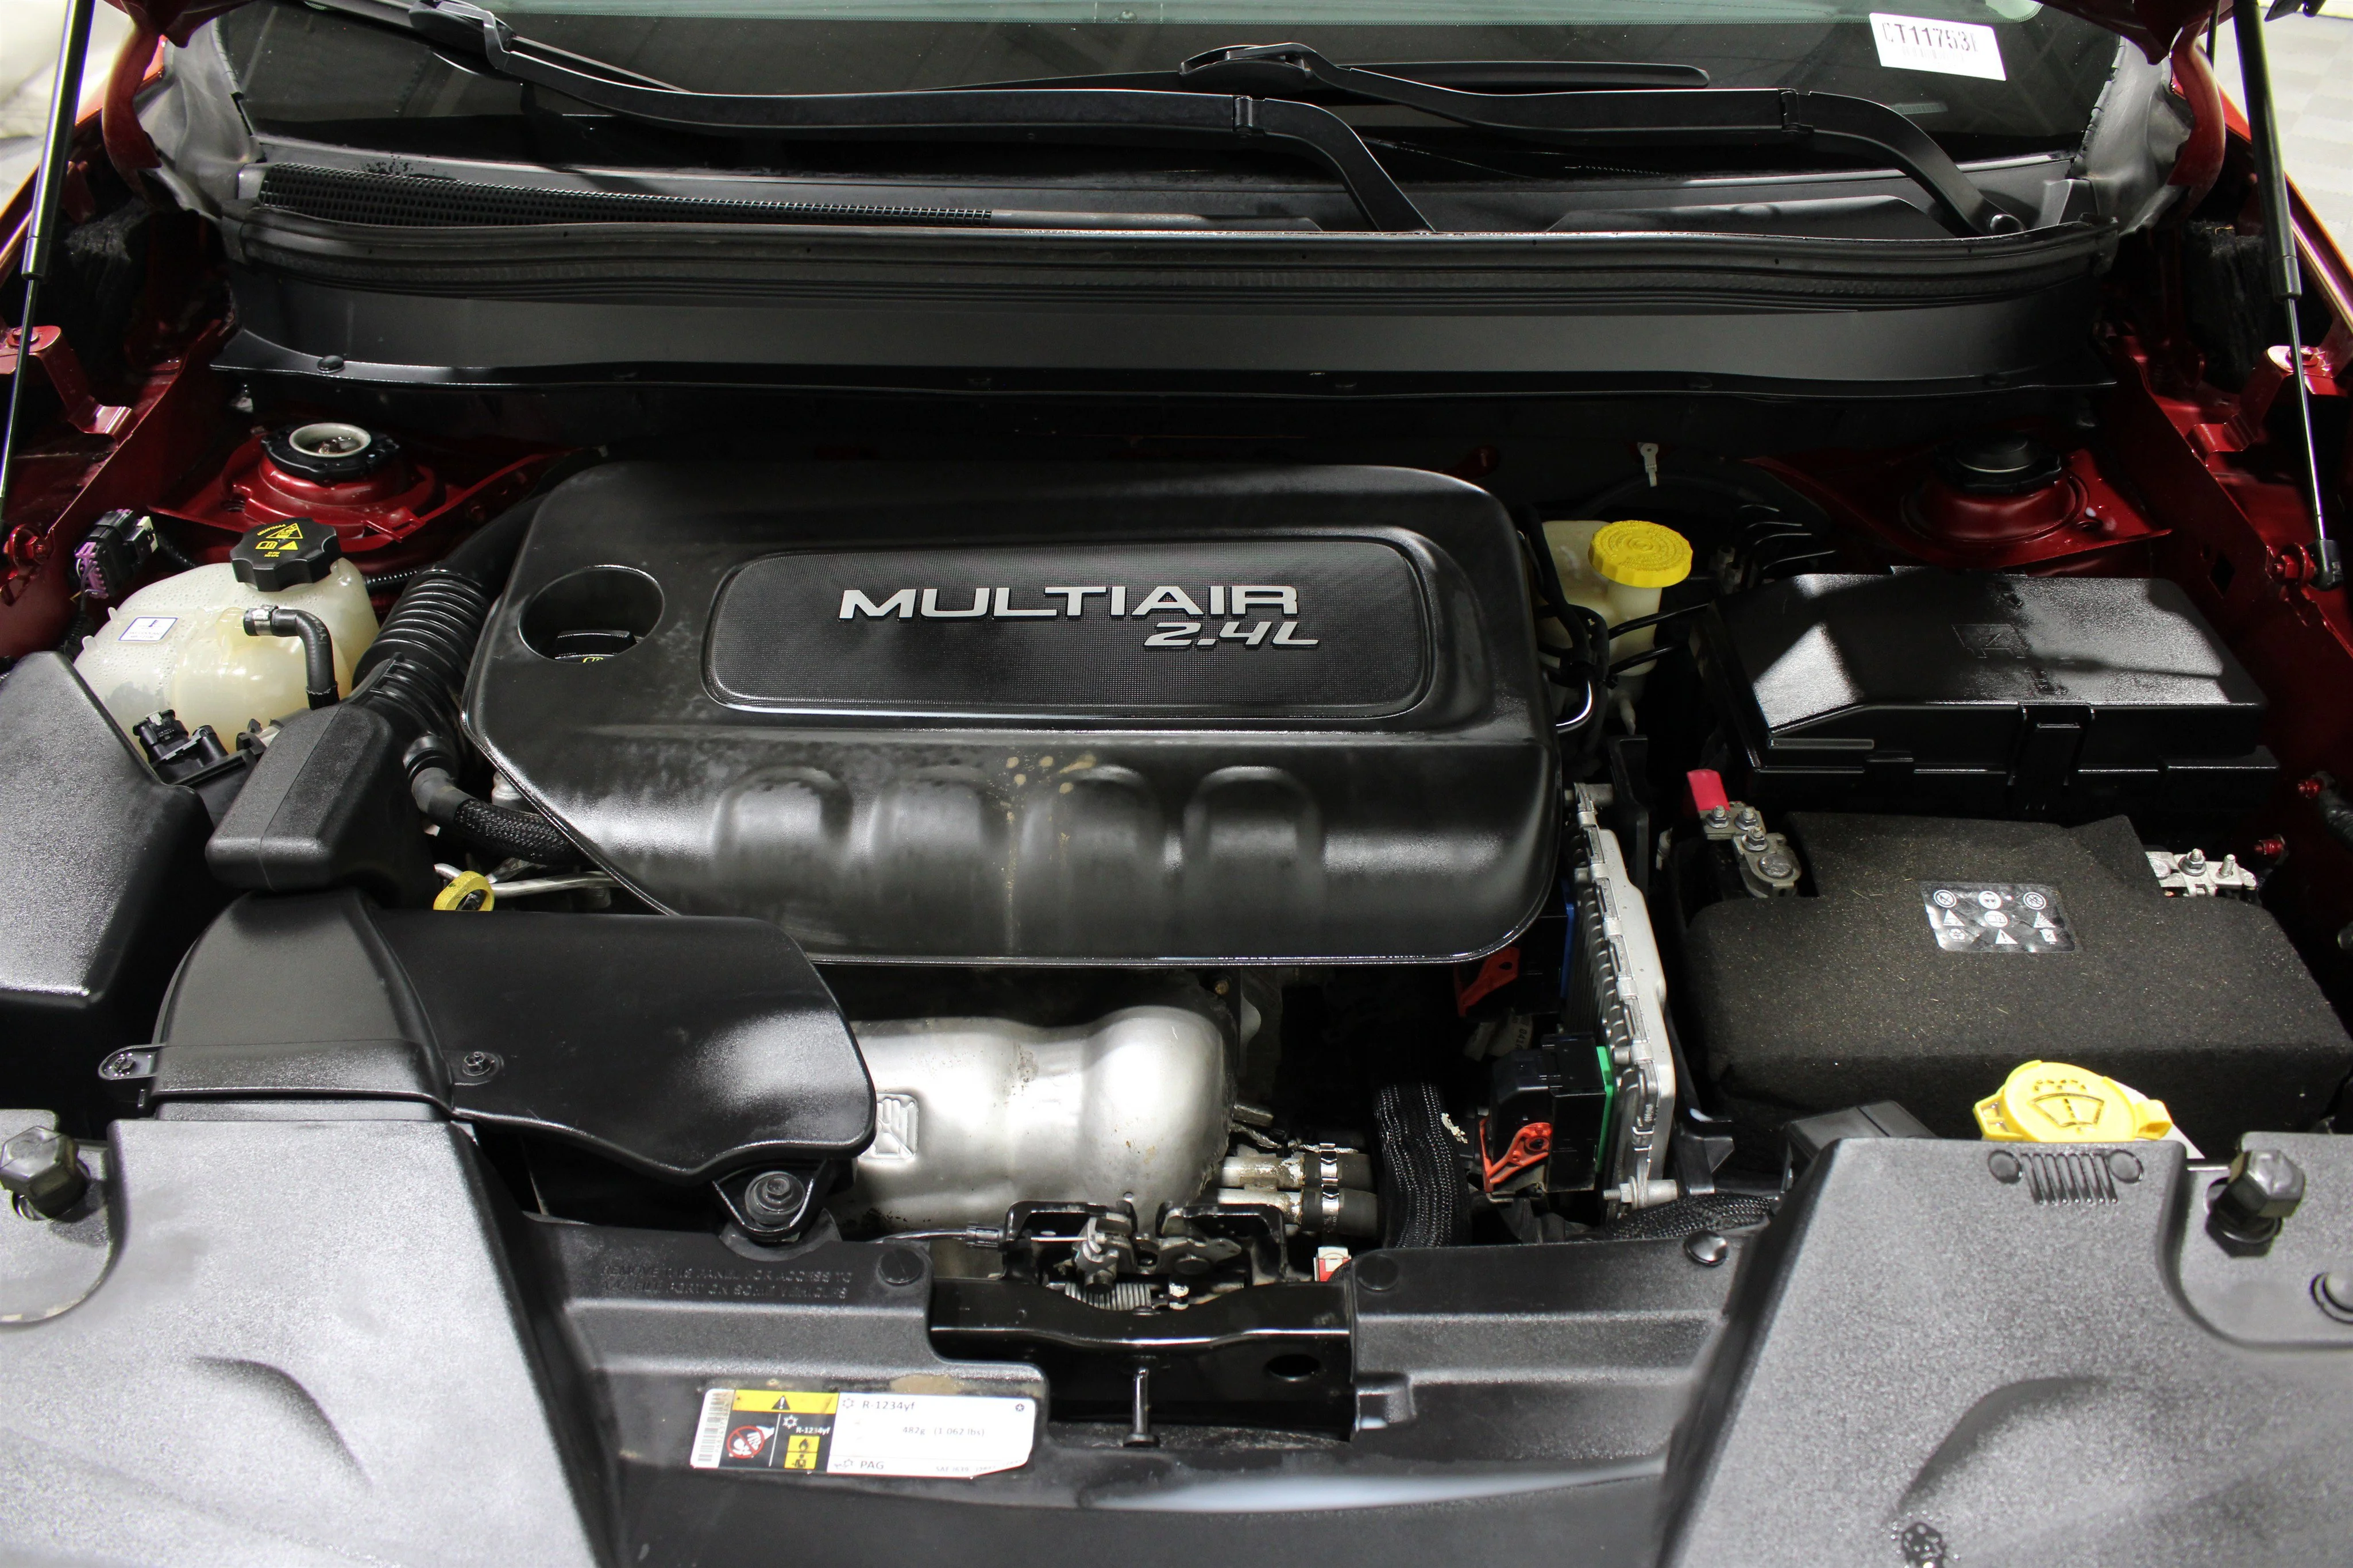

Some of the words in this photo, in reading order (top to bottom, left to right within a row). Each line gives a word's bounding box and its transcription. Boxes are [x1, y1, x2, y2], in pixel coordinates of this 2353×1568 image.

[838, 585, 1299, 619] MULTIAIR
[1145, 621, 1320, 647] 2.4L
[862, 1400, 915, 1412] R-1234yf
[796, 1426, 830, 1435] R-1234yf
[860, 1460, 885, 1470] PAG
